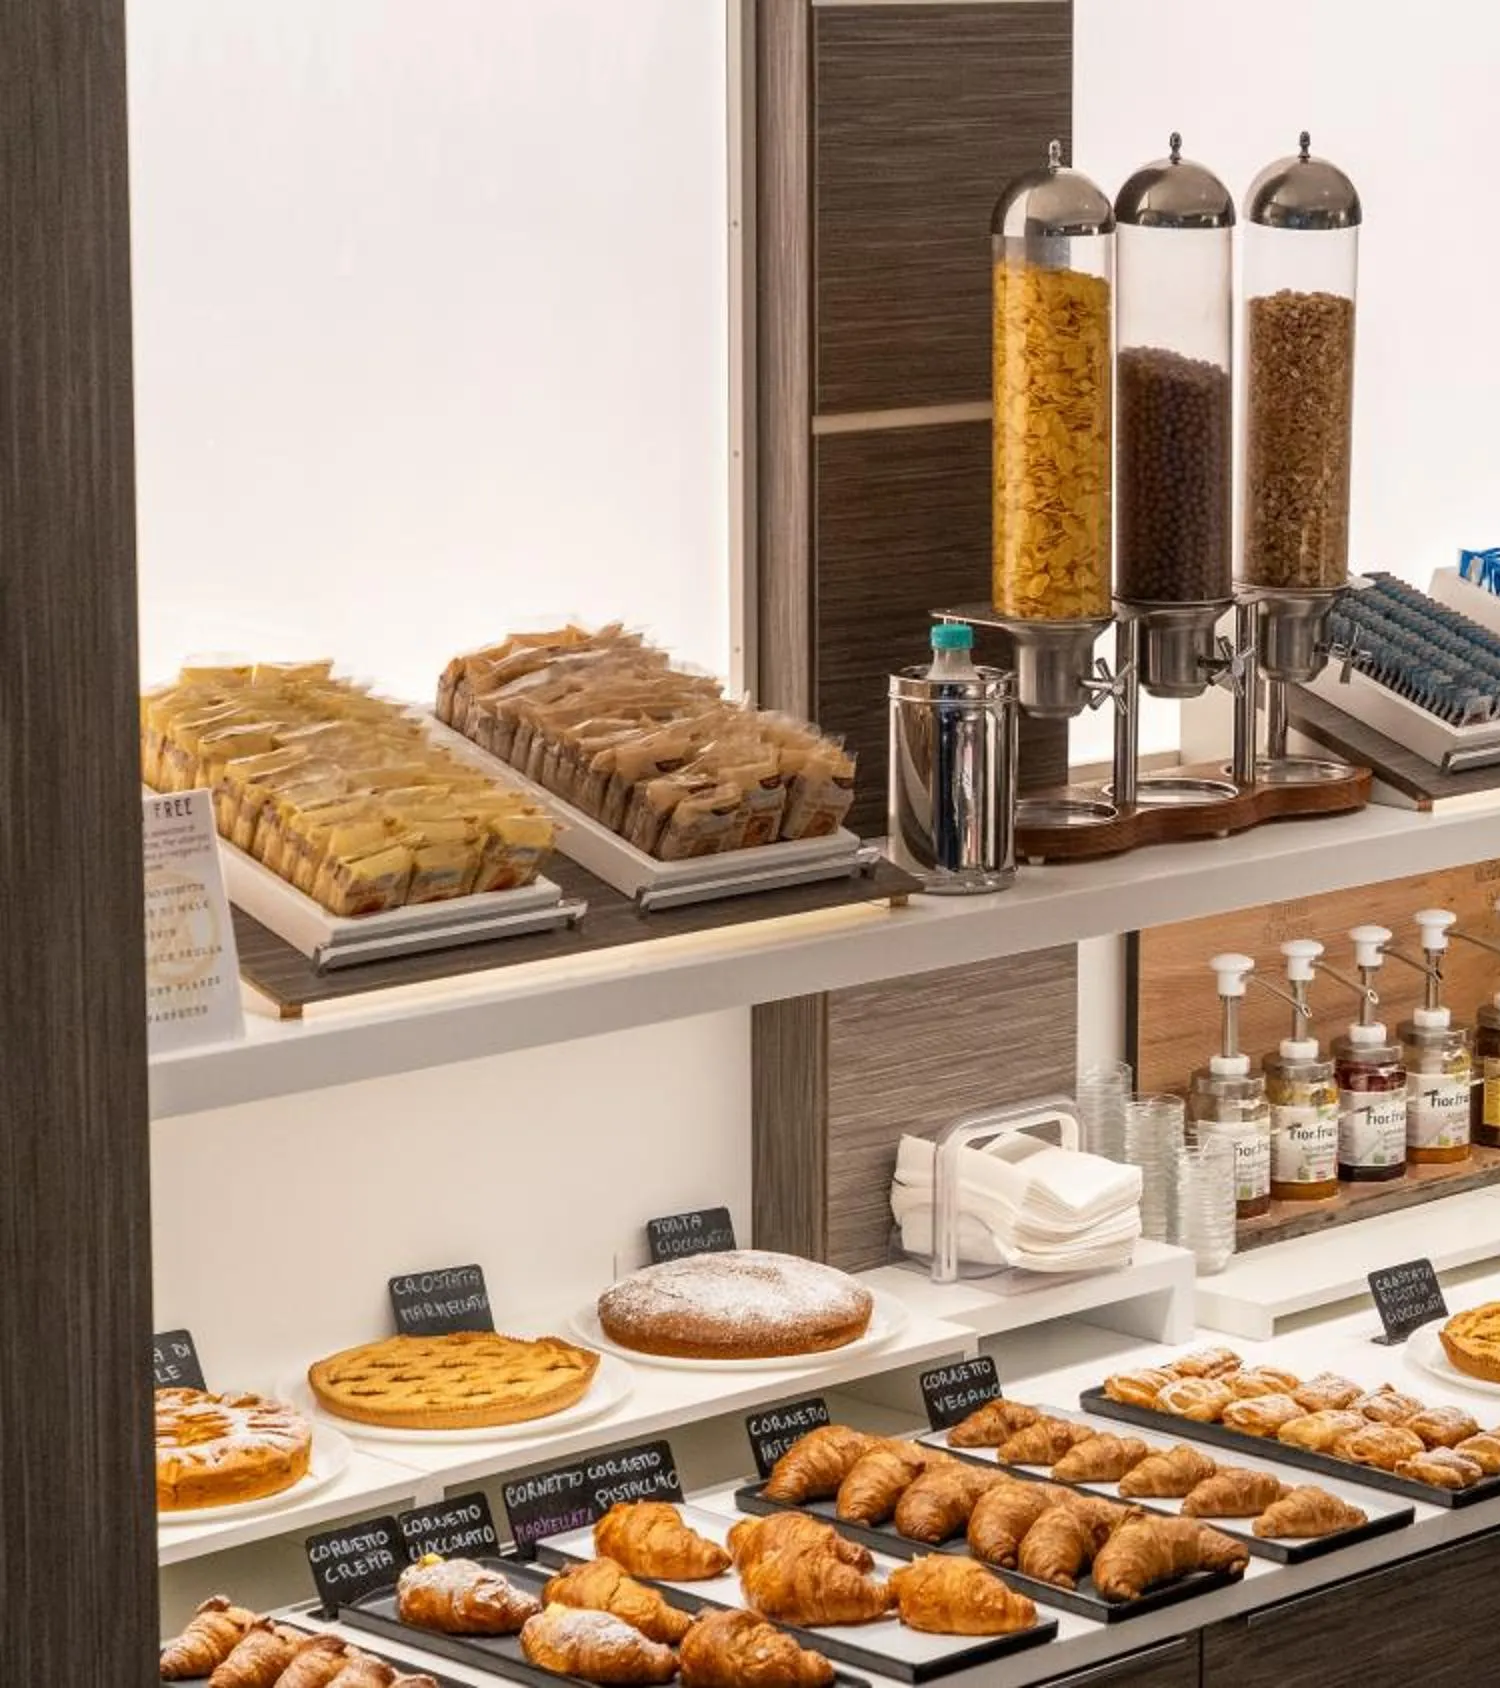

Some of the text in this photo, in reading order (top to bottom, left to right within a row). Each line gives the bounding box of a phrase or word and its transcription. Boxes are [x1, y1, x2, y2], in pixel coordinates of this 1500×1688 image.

[154, 798, 193, 818] FREE
[651, 1214, 703, 1236] TORTA
[392, 1268, 480, 1296] CROSTATA
[923, 1360, 992, 1391] CORNETTO
[933, 1383, 1001, 1413] VEGANO
[750, 1406, 827, 1435] CORNETTO
[587, 1451, 661, 1480] CORNETTO
[505, 1471, 583, 1508] CORNETTO
[402, 1504, 481, 1537] CORNETTO
[309, 1530, 390, 1563] CORNETTO
[324, 1550, 394, 1584] CREMA
